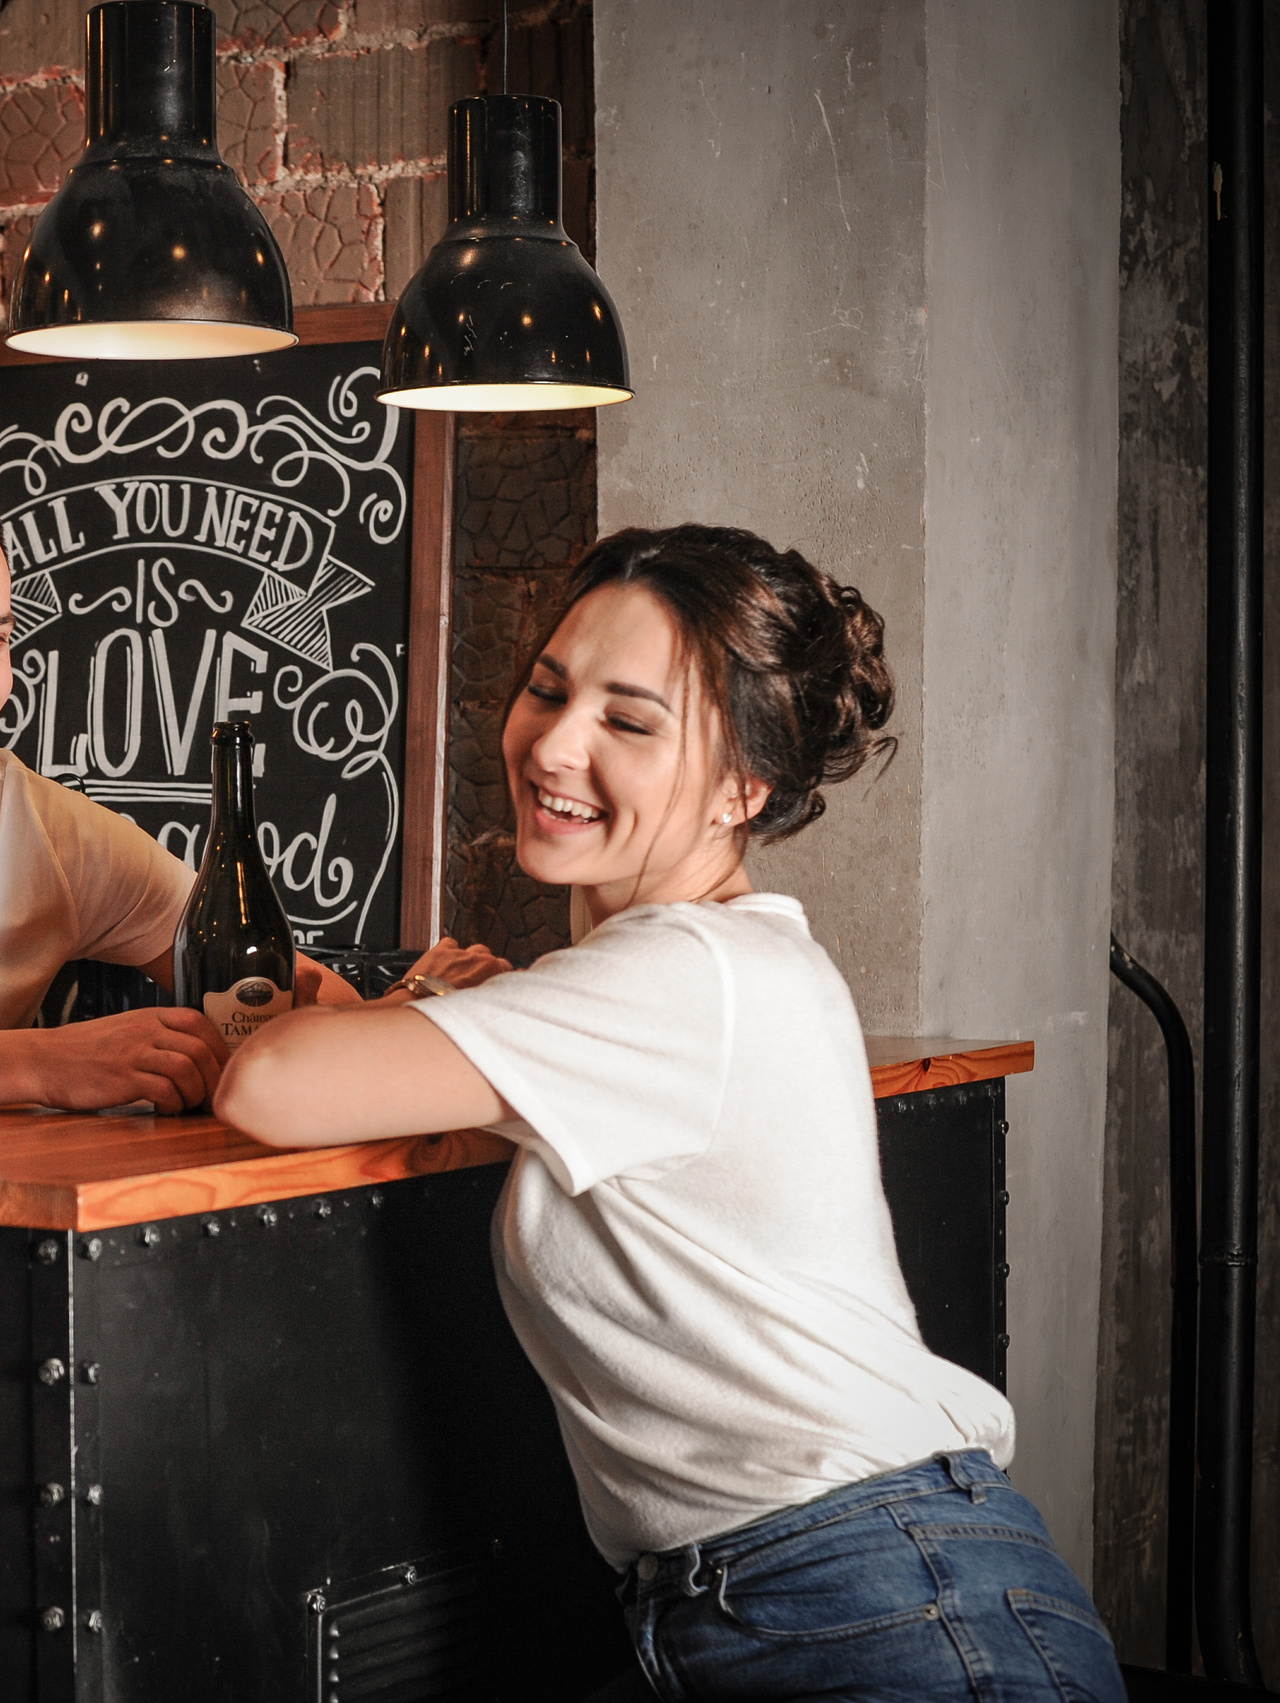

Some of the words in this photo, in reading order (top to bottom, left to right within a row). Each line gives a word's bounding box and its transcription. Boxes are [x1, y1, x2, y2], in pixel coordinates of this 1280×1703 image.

[5, 496, 85, 575] ALL
[94, 481, 191, 540] YOU
[194, 486, 314, 572] NEED
[135, 557, 179, 627] IS
[37, 627, 269, 778] LOVE
